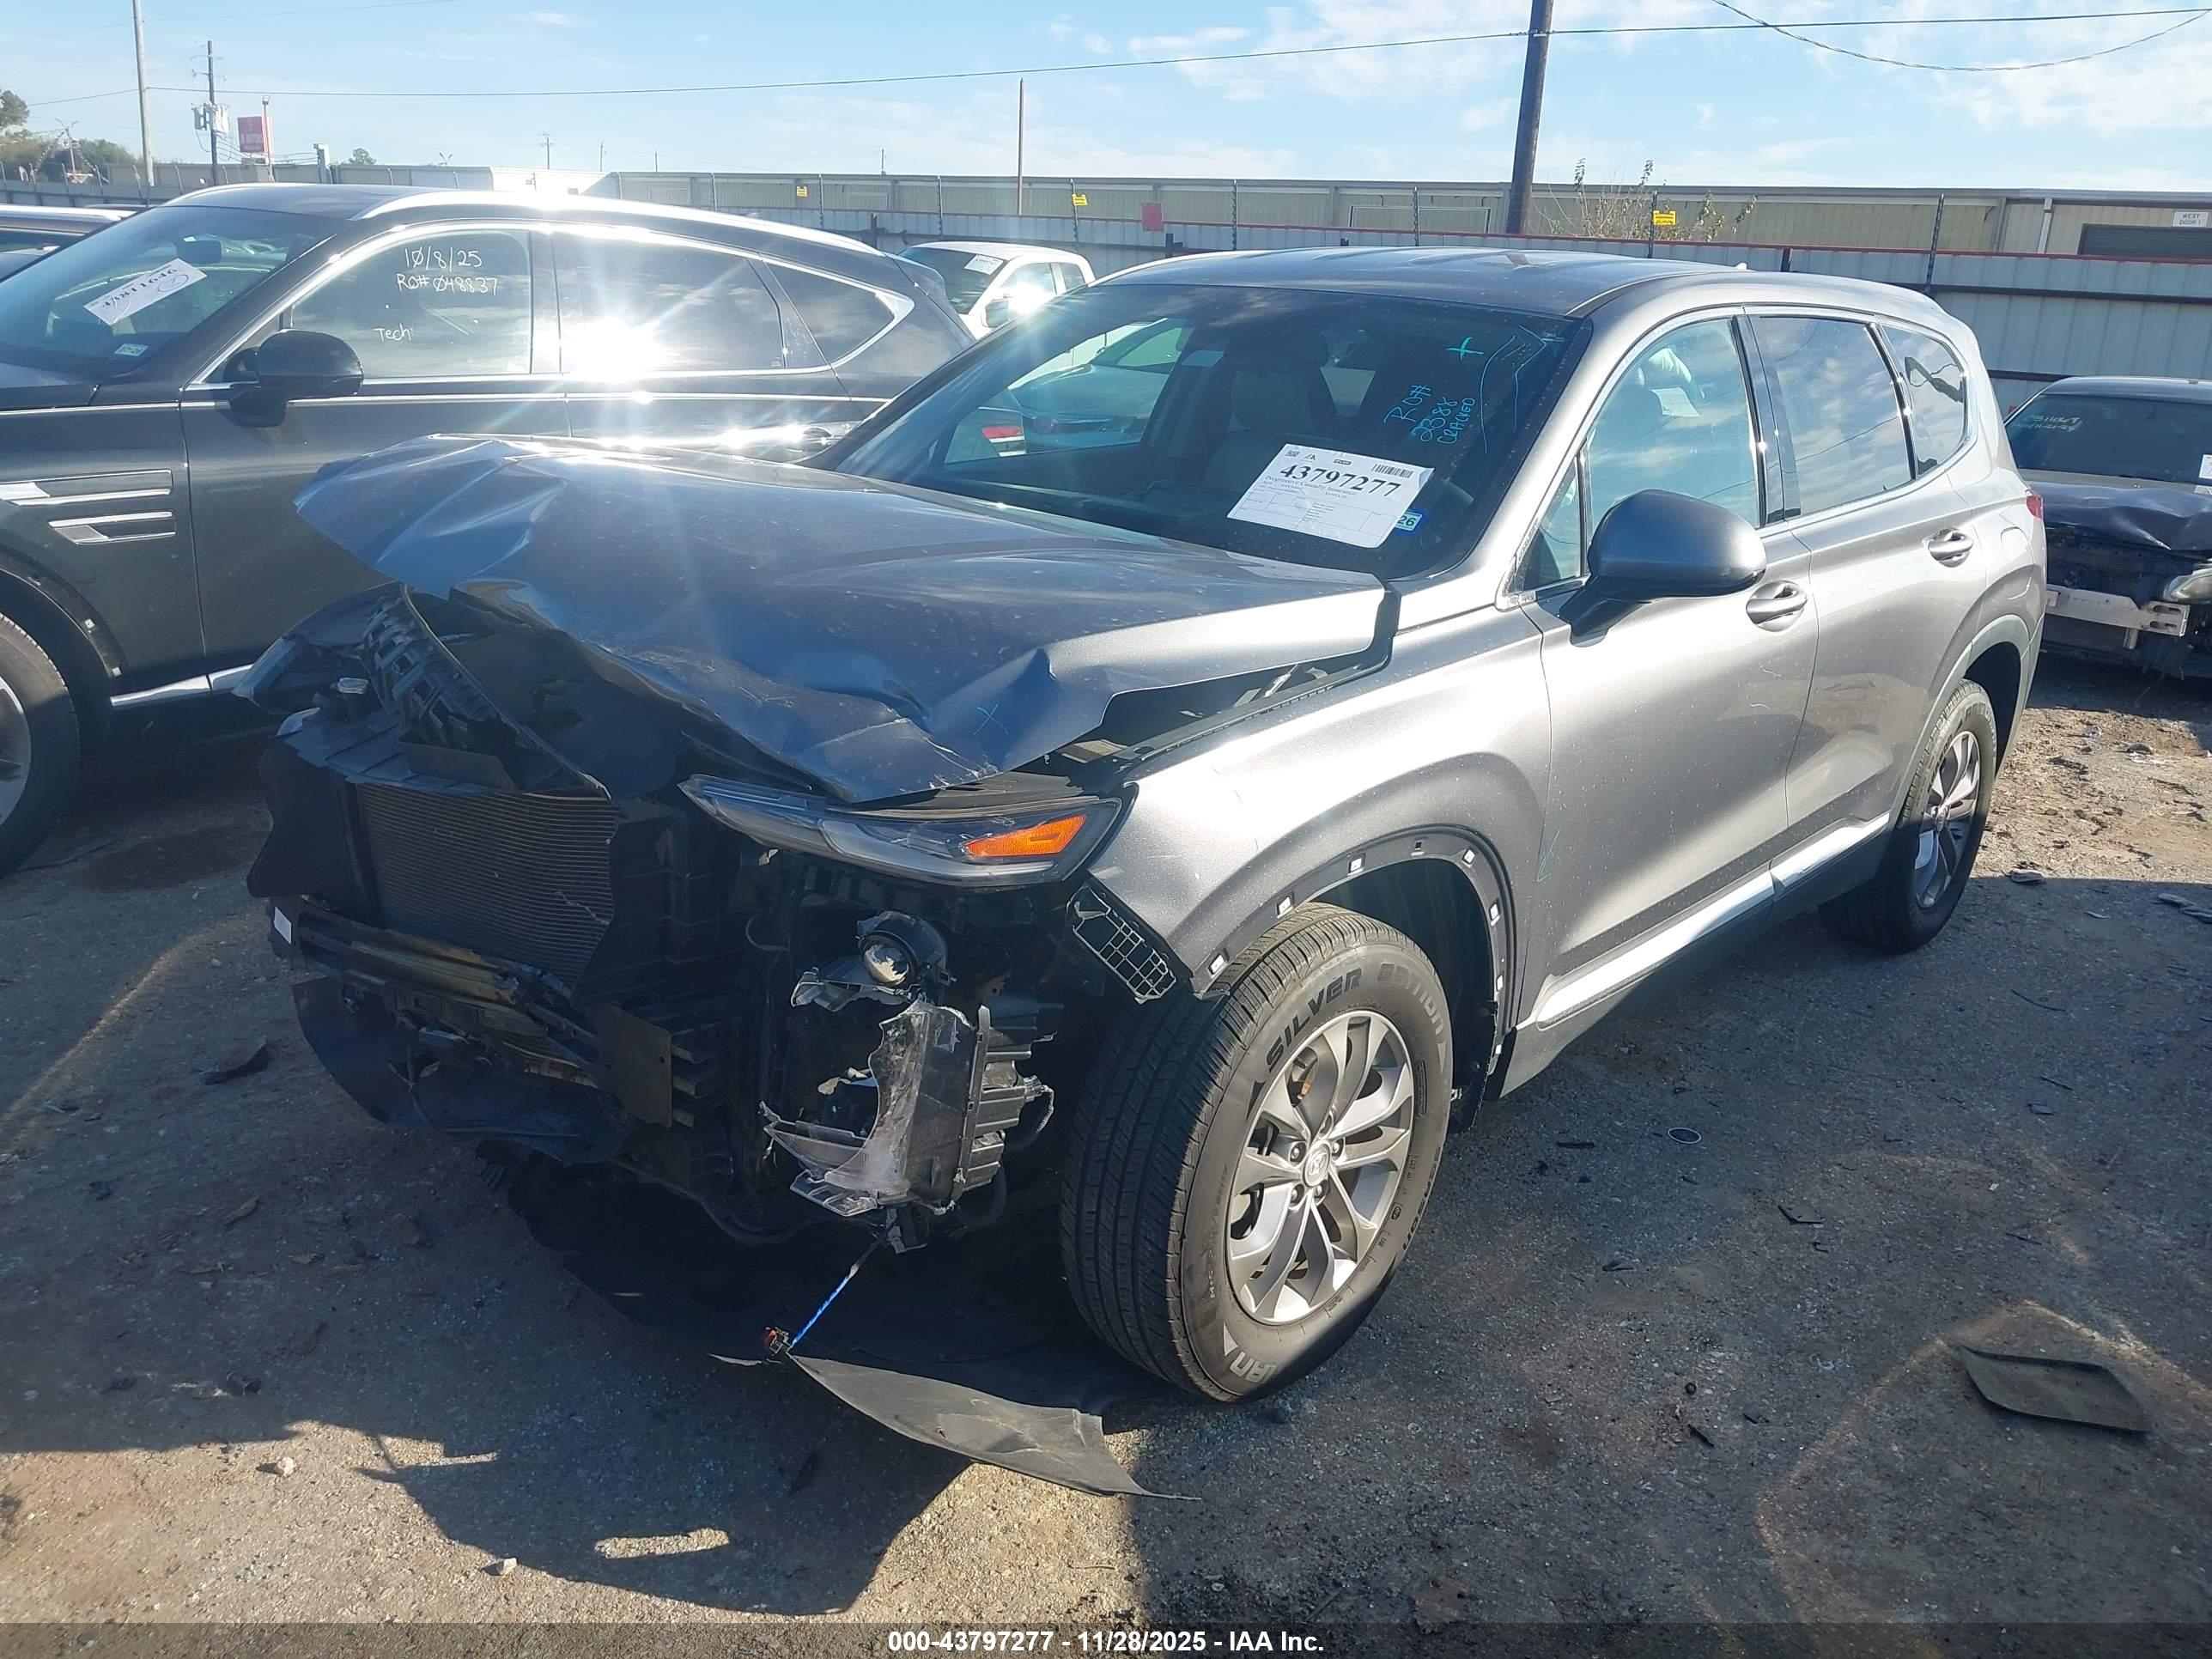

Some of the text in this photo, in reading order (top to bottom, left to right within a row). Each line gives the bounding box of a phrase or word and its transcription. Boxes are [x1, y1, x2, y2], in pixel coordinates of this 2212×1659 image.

[405, 246, 483, 272] 10/8/25
[397, 273, 498, 295] RO# 048837
[1279, 464, 1401, 497] 43797277
[1300, 481, 1327, 491] Casualty
[1327, 486, 1357, 496] Insurance
[1398, 515, 1417, 527] 26
[1266, 963, 1446, 1073] SILVER EDITION
[1207, 1269, 1217, 1299] M+S
